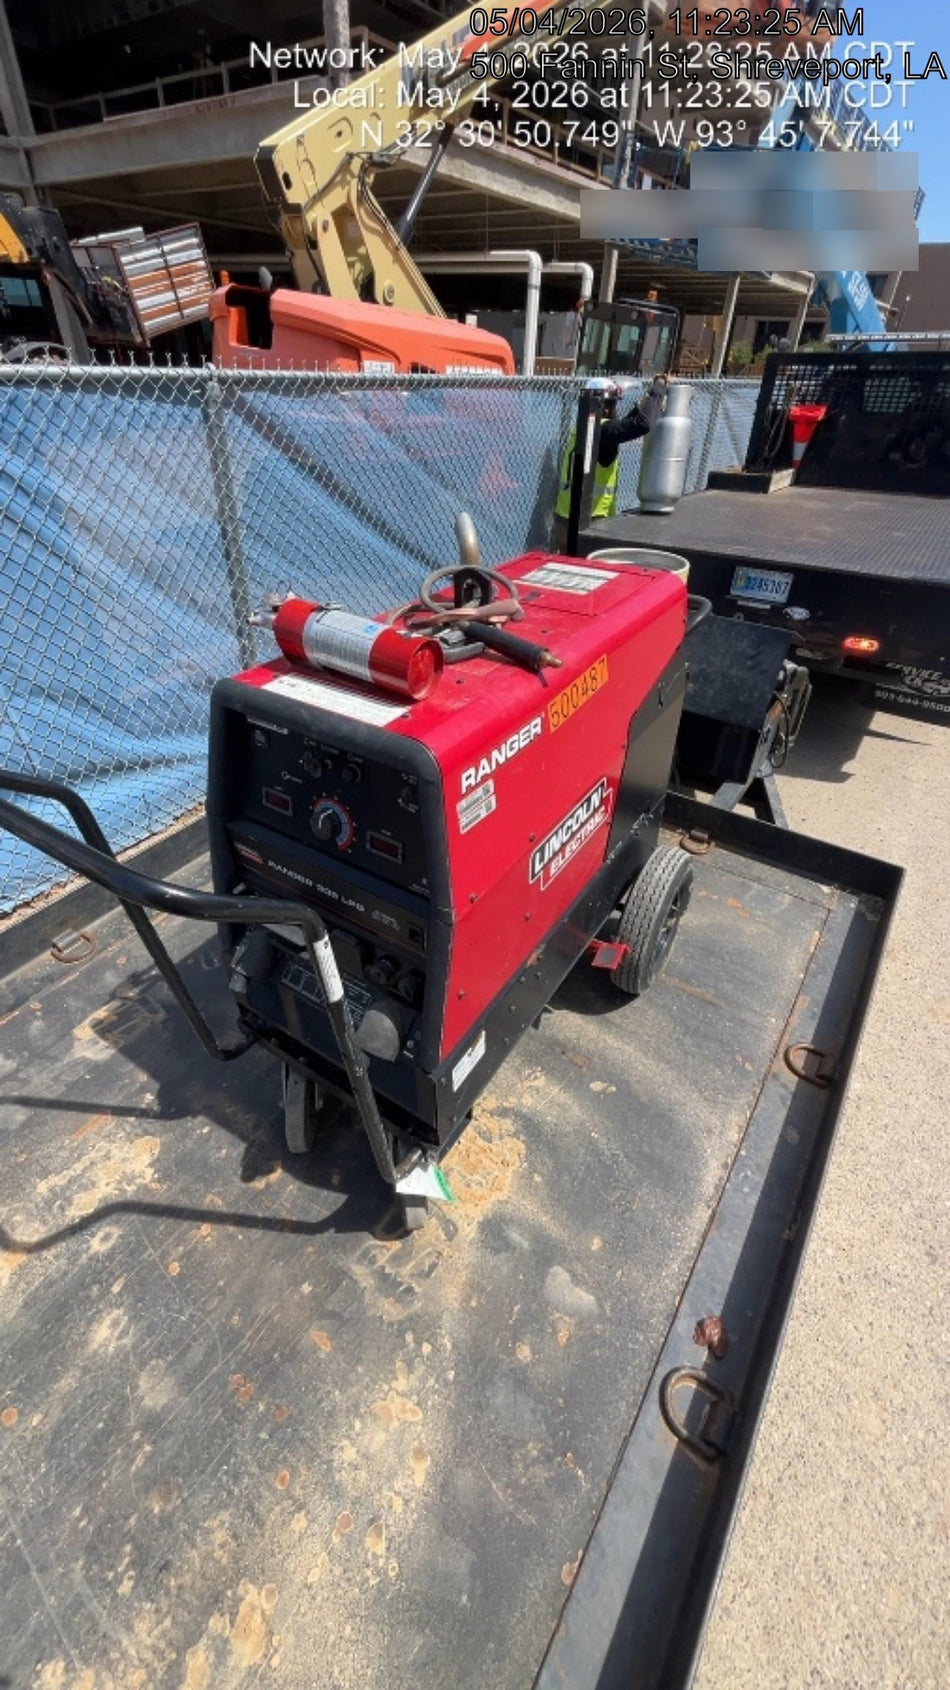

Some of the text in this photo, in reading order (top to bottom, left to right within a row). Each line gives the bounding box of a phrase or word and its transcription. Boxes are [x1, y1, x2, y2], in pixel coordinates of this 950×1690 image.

[550, 658, 606, 728] 500487
[461, 716, 542, 795] RANGER
[534, 785, 604, 875] LINCOLN
[550, 805, 606, 877] ELECTRIC
